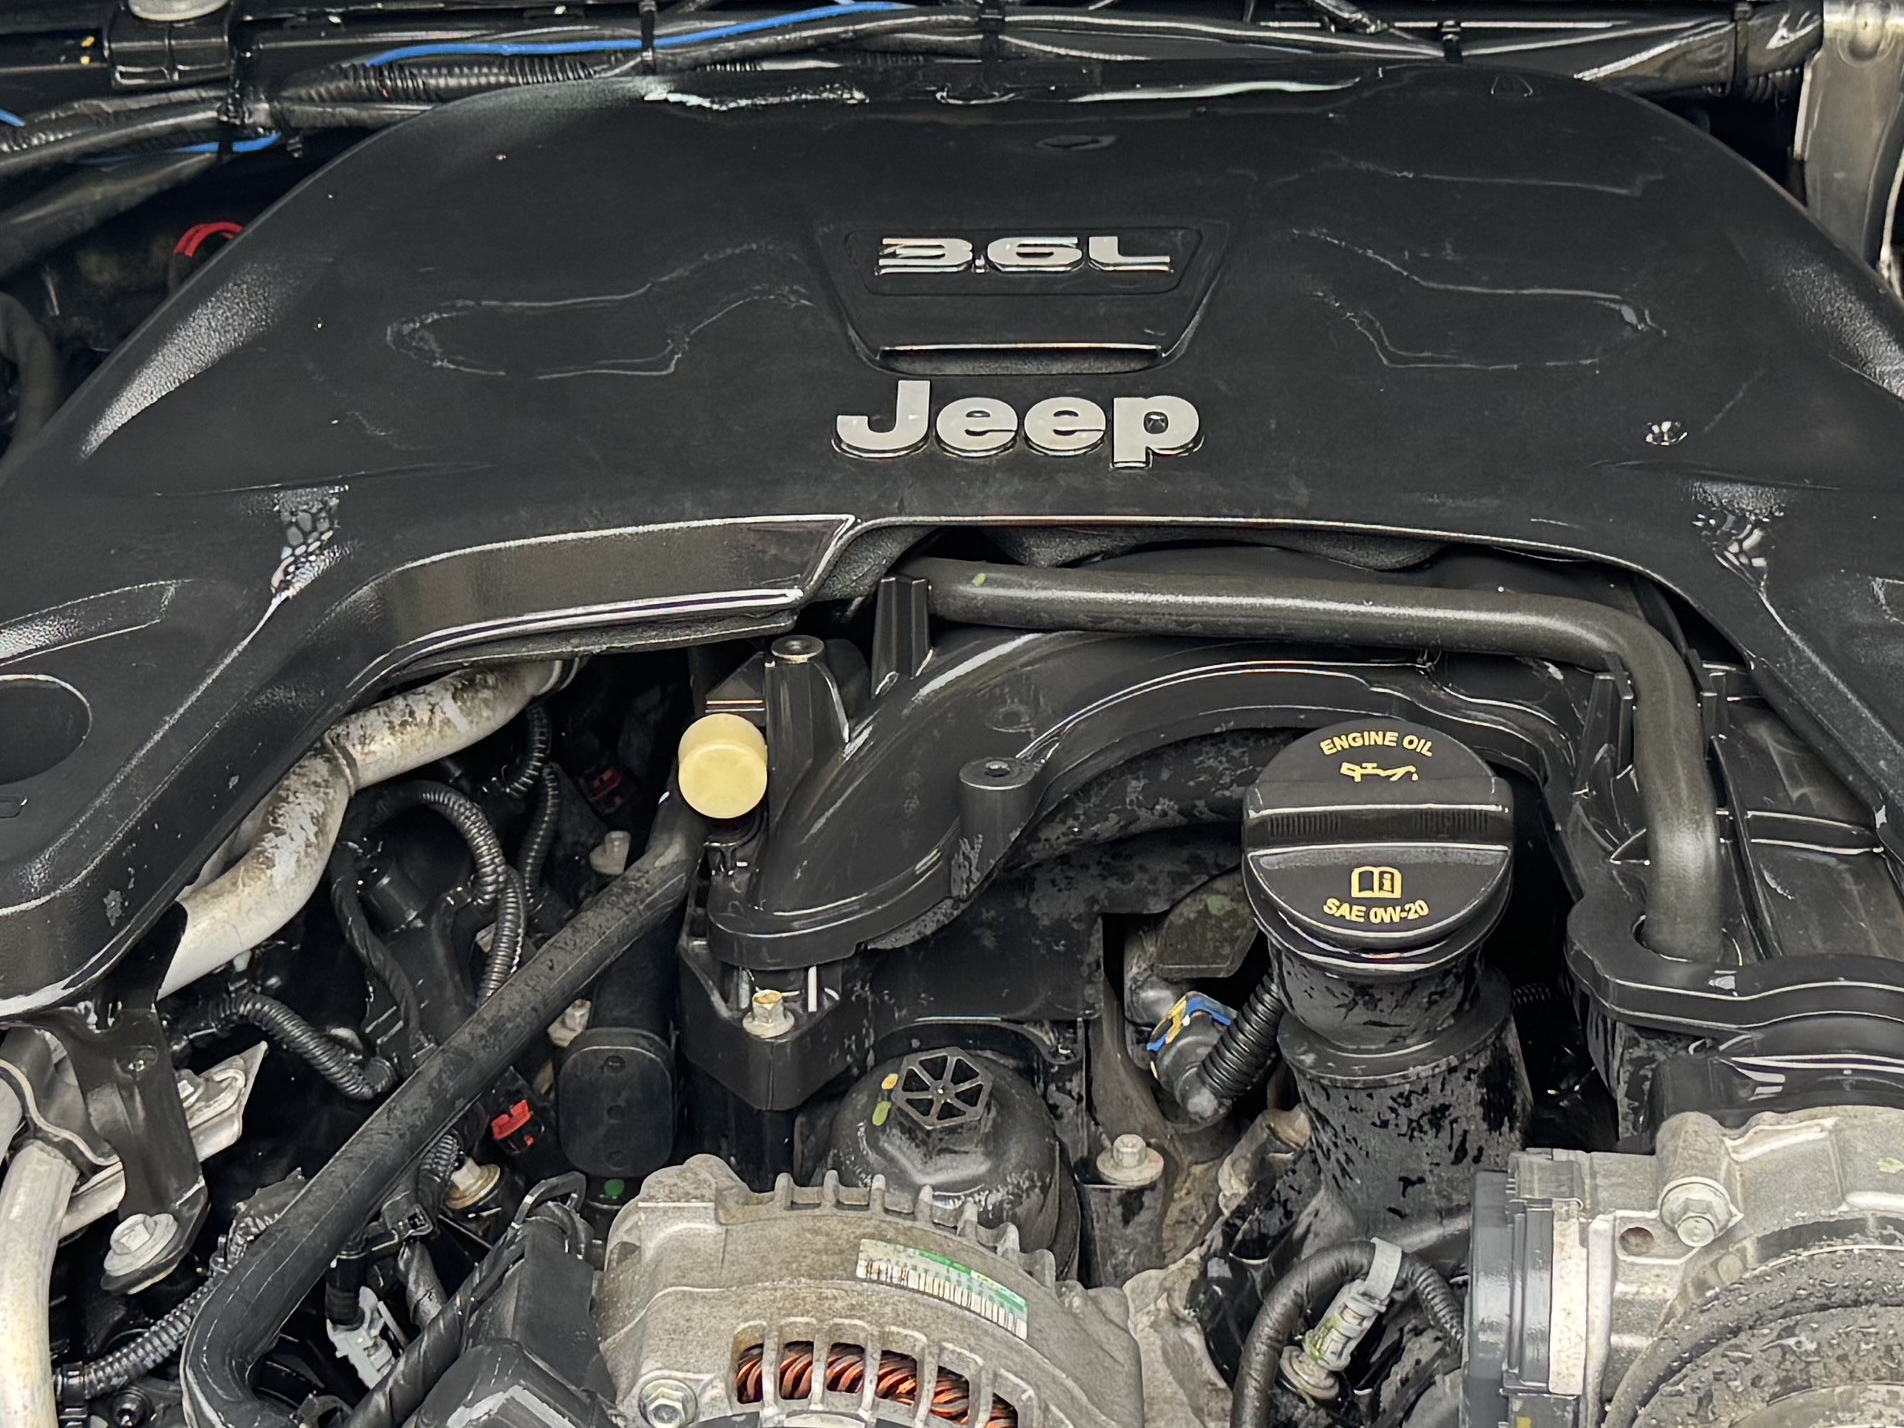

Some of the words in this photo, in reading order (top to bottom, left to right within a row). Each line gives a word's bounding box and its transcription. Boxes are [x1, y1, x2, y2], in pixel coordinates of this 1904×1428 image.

[878, 236, 1172, 273] 3.6L
[834, 380, 1202, 466] Jeep
[1320, 731, 1398, 755] ENGINE
[1402, 734, 1433, 757] OIL
[1323, 897, 1366, 923] SAE
[1369, 899, 1429, 923] 0W-20
